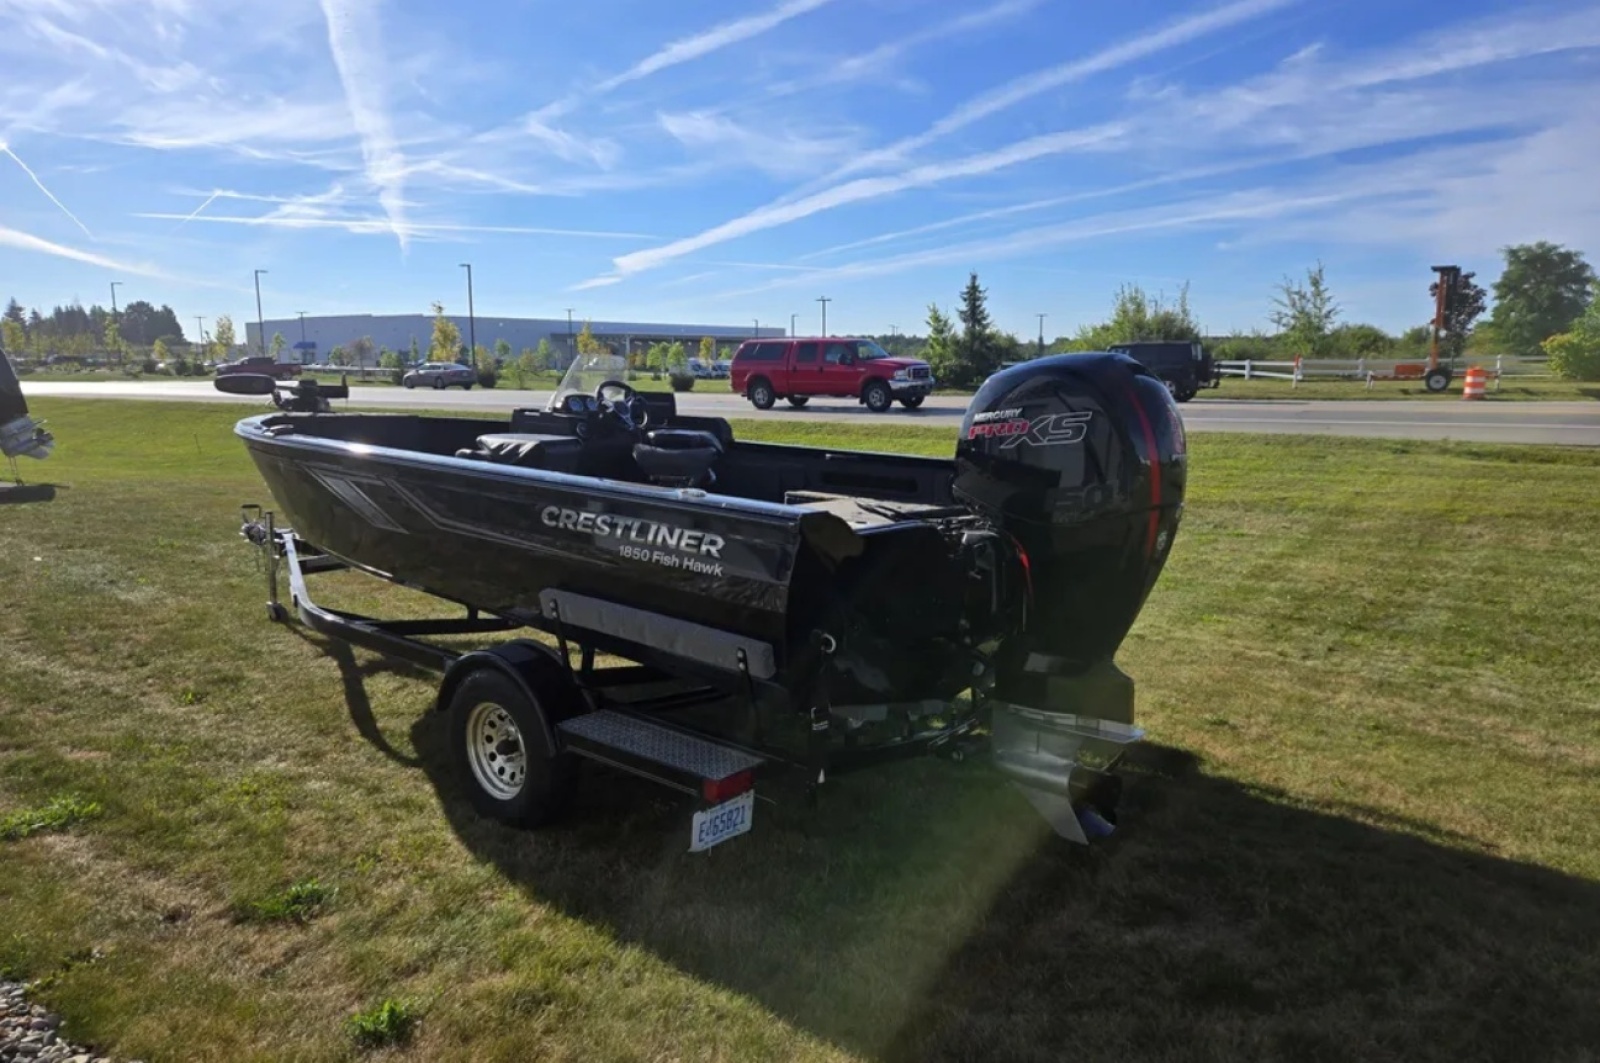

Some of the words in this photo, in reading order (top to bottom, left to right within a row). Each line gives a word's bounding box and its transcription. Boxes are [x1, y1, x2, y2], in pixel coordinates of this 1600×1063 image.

[541, 506, 726, 557] CRESTLINER
[618, 545, 650, 562] 1850
[652, 553, 680, 568] Fish
[682, 558, 723, 577] Hawk
